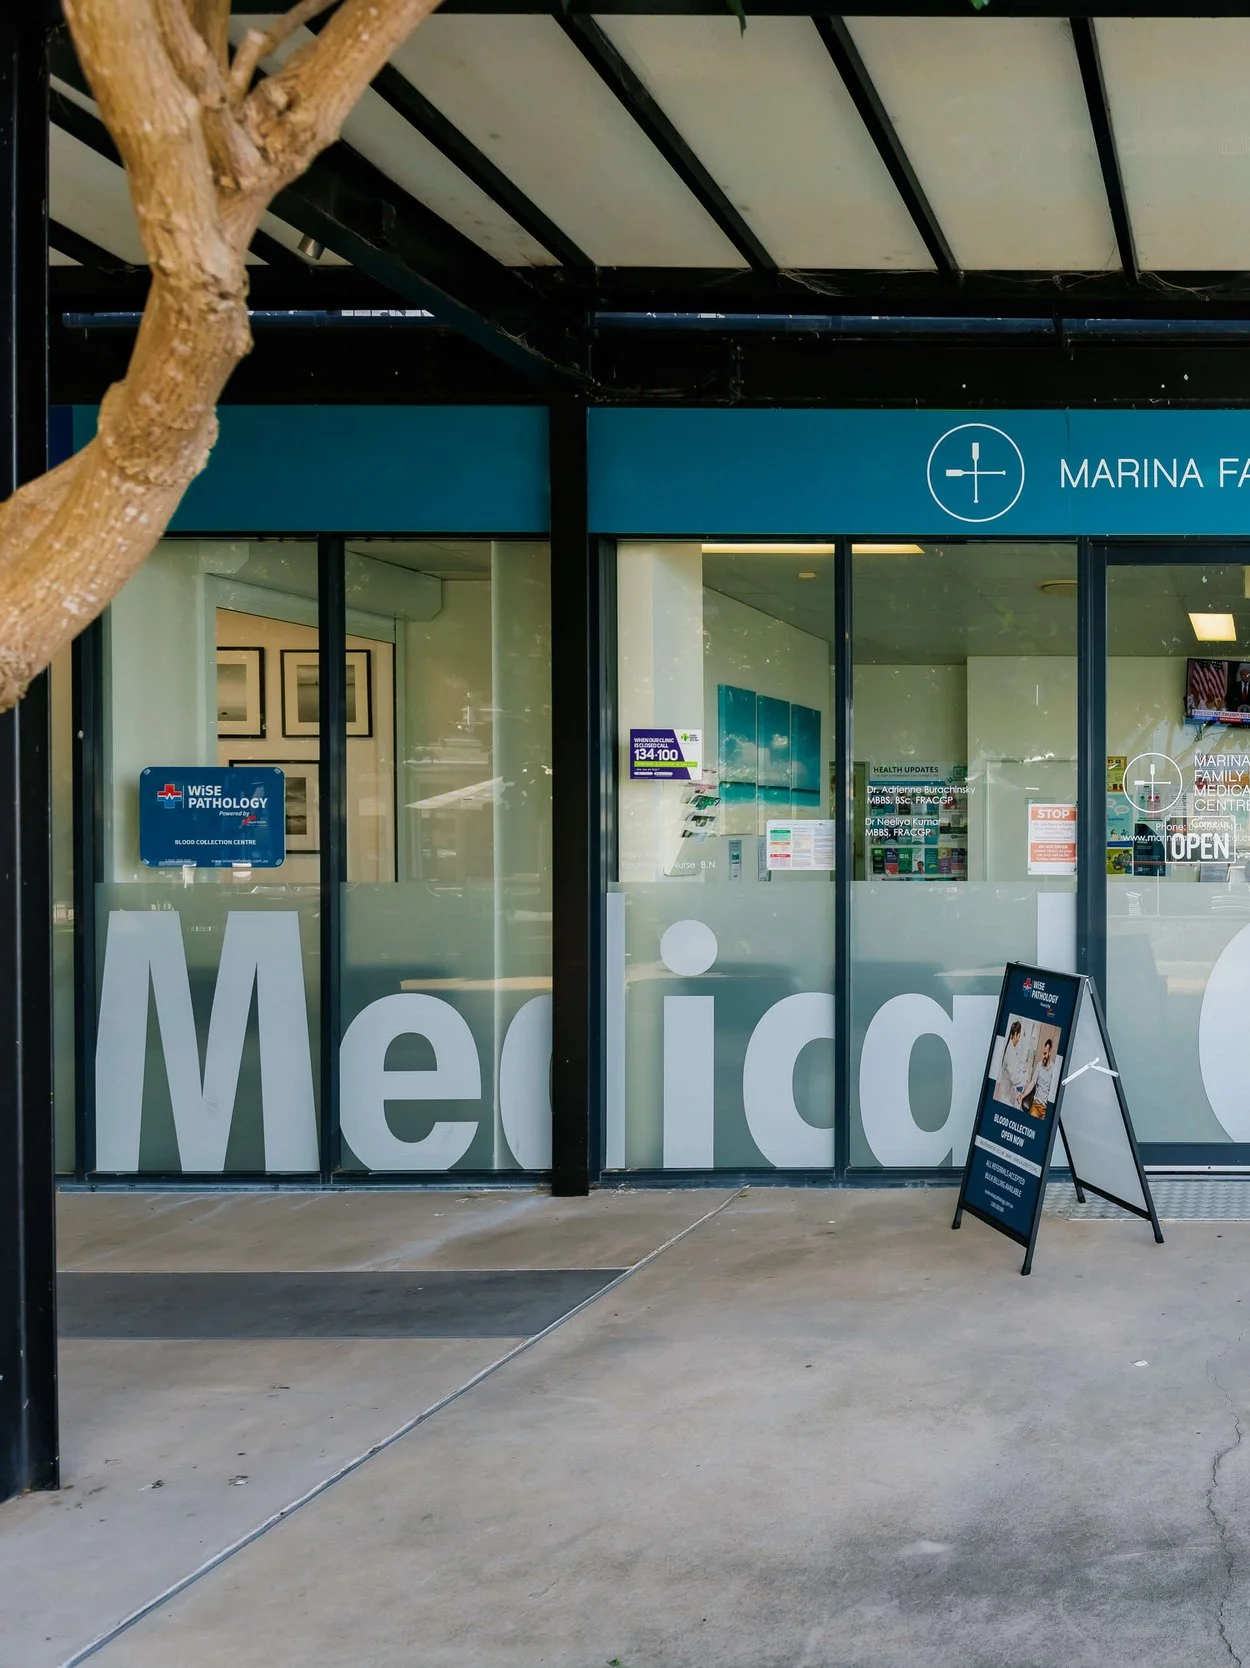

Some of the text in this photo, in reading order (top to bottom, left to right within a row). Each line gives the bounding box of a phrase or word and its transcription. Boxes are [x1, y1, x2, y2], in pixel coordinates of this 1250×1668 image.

[1059, 458, 1203, 489] MARINA
[1194, 755, 1250, 766] MARINA
[1194, 770, 1244, 781] FAMILY
[188, 785, 222, 796] WiSE
[881, 785, 922, 794] Adrienne
[924, 785, 976, 796] Burachinsky
[188, 797, 268, 808] PATHOLOGY
[915, 796, 954, 805] FRACGP
[241, 810, 250, 818] by
[1037, 809, 1070, 818] STOP
[865, 817, 874, 826] Dr
[877, 817, 911, 828] Neeliya
[1155, 823, 1187, 831] Phone:
[893, 828, 931, 837] FRACGP
[1171, 832, 1230, 860] OPEN
[1031, 990, 1059, 1004] PATHOLOGY
[993, 1113, 1036, 1140] BLOOD COLLECTION
[1001, 1129, 1025, 1147] OPEN NOW
